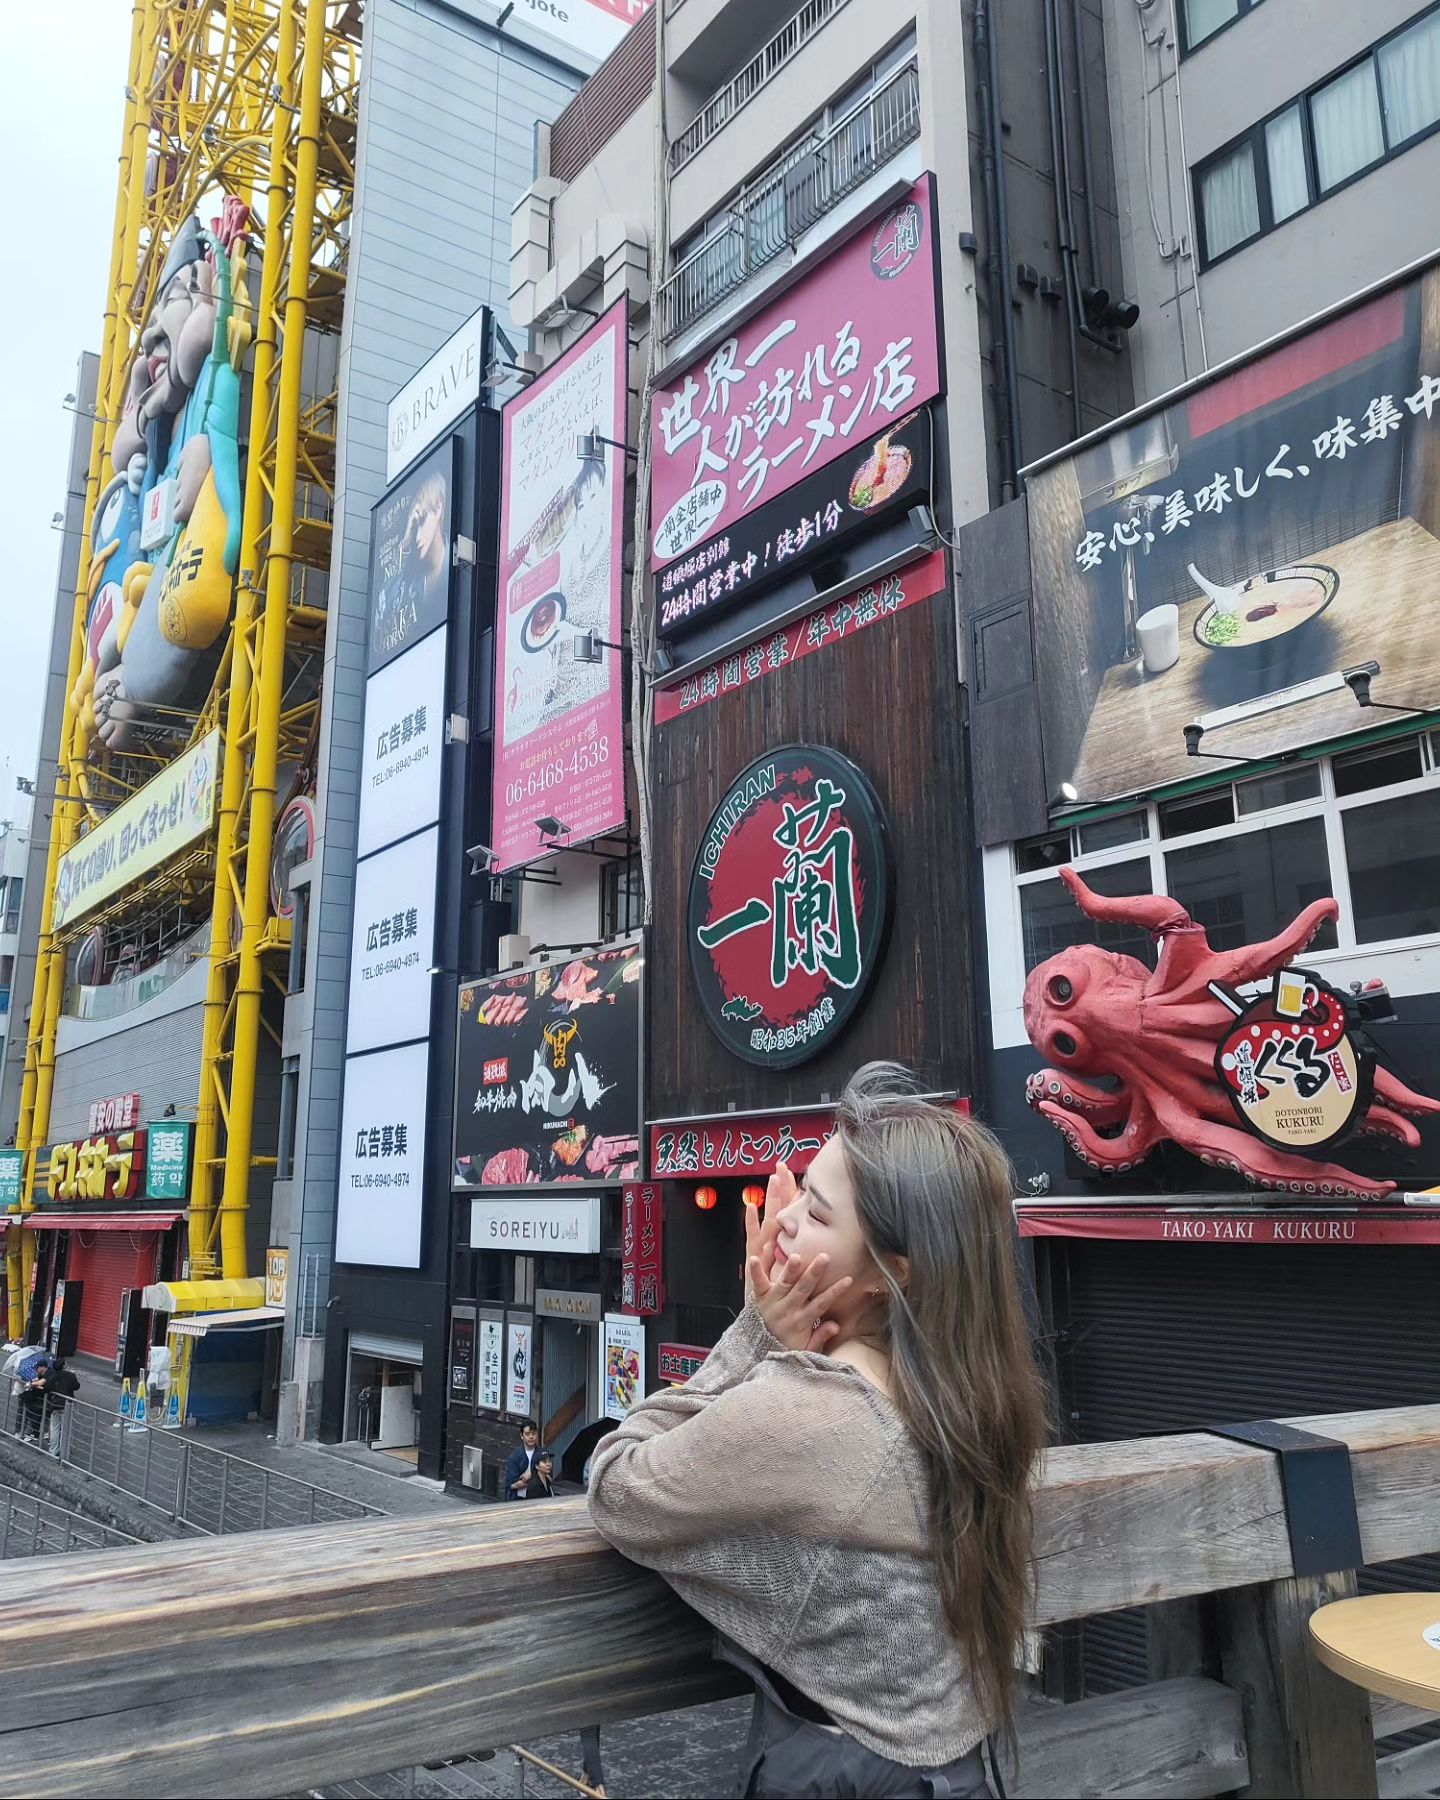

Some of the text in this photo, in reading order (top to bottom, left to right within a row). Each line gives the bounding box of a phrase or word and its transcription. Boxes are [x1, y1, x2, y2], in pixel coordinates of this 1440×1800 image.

[524, 0, 569, 23] jote
[411, 343, 475, 431] BRAVE
[659, 320, 796, 456] 世界一
[690, 321, 861, 489] 人が訪れる
[737, 336, 916, 509] ラーメン店
[655, 484, 722, 548] 一蘭全店舗中
[670, 517, 710, 555] 世界一
[376, 704, 427, 760] 広告募集
[371, 744, 430, 788] TEL:06-6940-4974
[505, 736, 610, 807] 06-6468-4538
[699, 764, 777, 881] ICHIRAN
[698, 778, 862, 989] 一蘭
[366, 907, 418, 952] 広告募集
[361, 951, 420, 981] TEL:06-6940-4974
[750, 997, 837, 1053] 昭和35年創業
[1254, 1036, 1332, 1099] くくる
[1275, 1106, 1323, 1118] DOTONBORI
[1276, 1115, 1325, 1129] KUKURU
[152, 1131, 184, 1163] 薬
[355, 1123, 408, 1159] 広告募集
[150, 1164, 184, 1172] Medicine
[350, 1172, 410, 1189] TEL:06-6940-4974
[489, 1211, 560, 1241] SOREIYU
[1161, 1220, 1357, 1240] TAKO-YAKI KUKURU
[661, 1353, 705, 1377] お土産販
